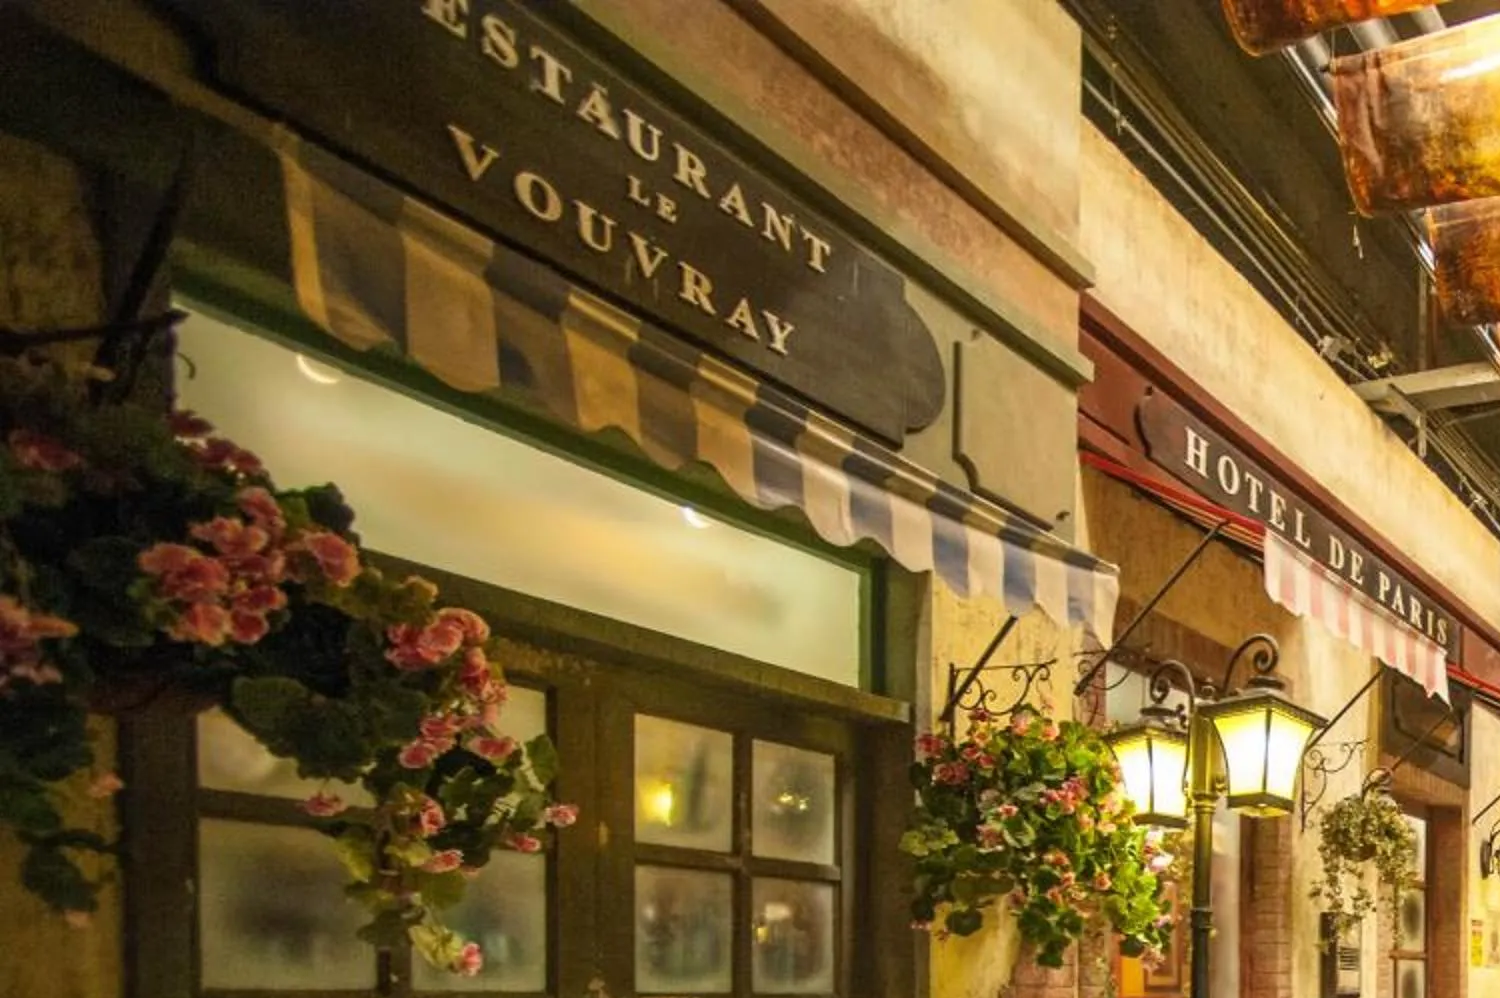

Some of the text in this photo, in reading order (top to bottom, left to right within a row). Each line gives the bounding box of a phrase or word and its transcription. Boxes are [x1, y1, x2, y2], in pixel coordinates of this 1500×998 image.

[447, 124, 796, 356] VOUVRAY
[627, 174, 679, 224] LE
[1184, 426, 1450, 647] HOTEL DE PARIS
